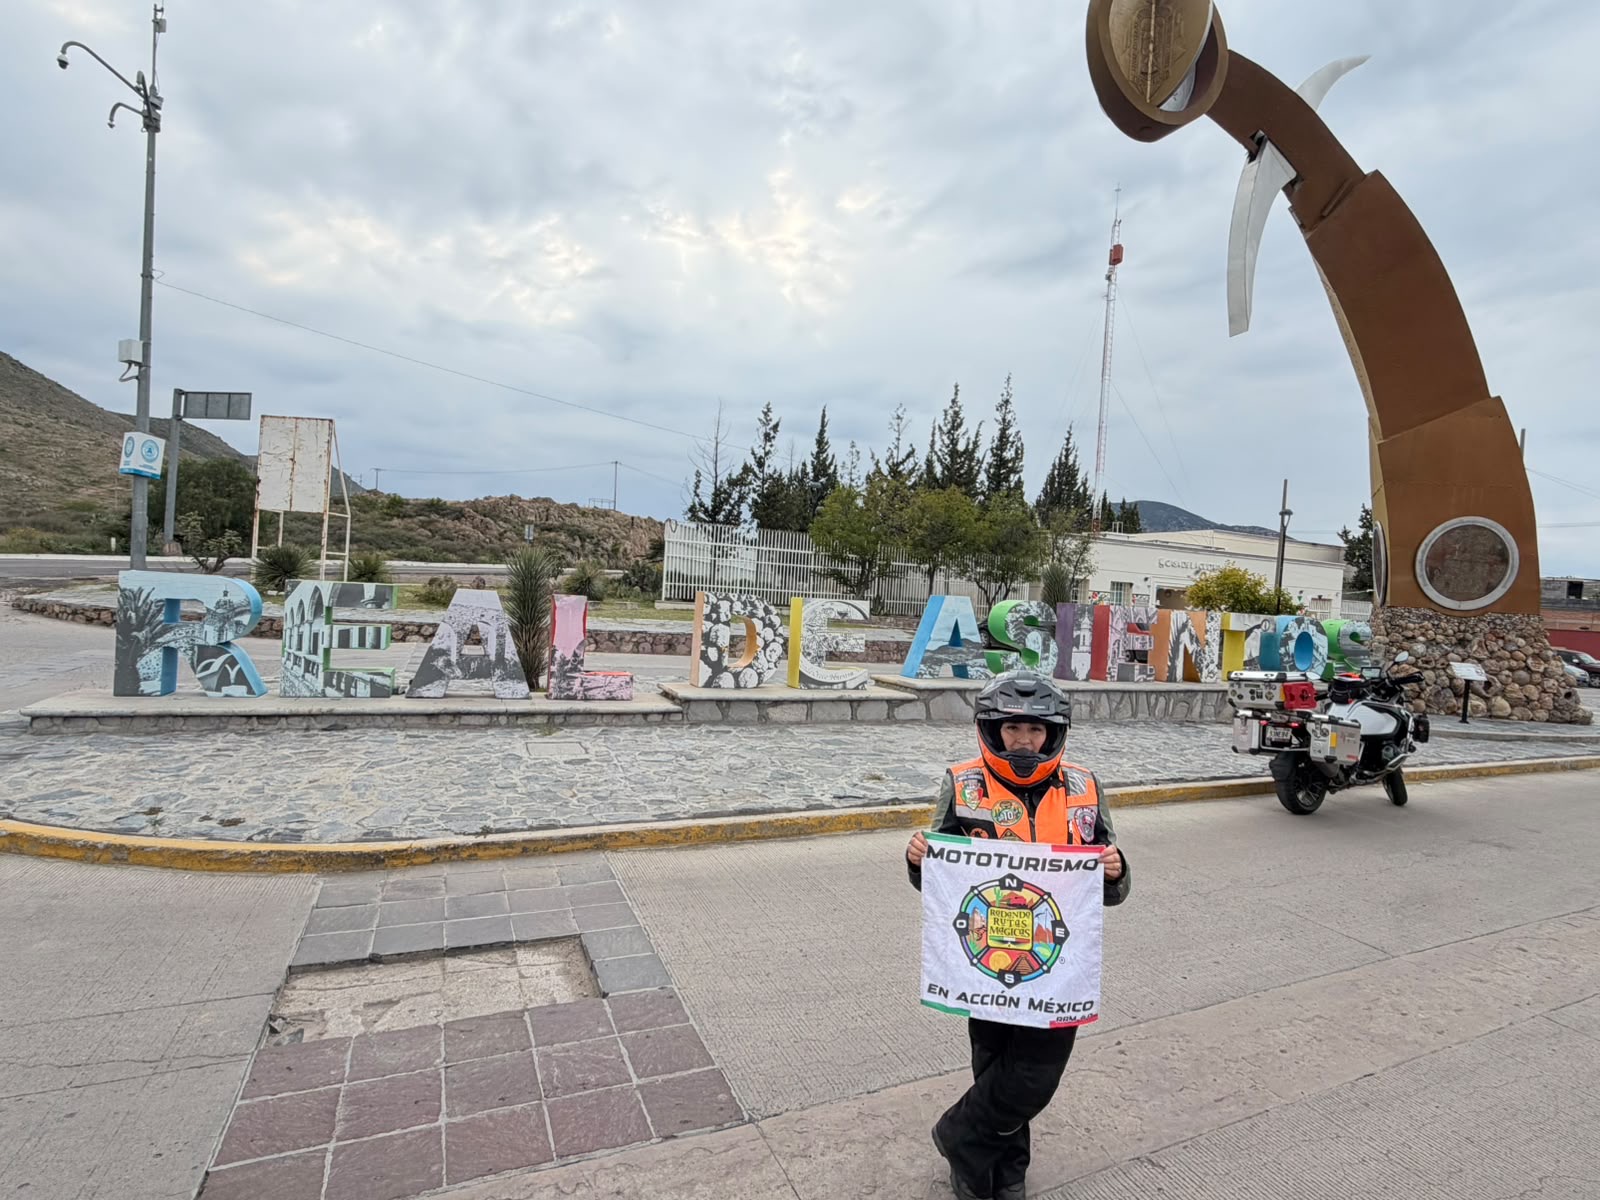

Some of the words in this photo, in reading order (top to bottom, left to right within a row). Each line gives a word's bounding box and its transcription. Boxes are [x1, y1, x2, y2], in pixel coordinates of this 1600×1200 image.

[113, 570, 634, 700] REAL
[692, 591, 871, 691] DE
[901, 595, 1373, 683] ASIENTOS
[926, 845, 1099, 873] MOTOTURISMO
[1005, 878, 1017, 888] N
[956, 919, 967, 929] O
[1055, 927, 1066, 938] E
[1004, 973, 1015, 984] S
[927, 983, 949, 999] EN
[956, 990, 1020, 1009] ACCIÓN
[1027, 998, 1095, 1014] MÉXICO
